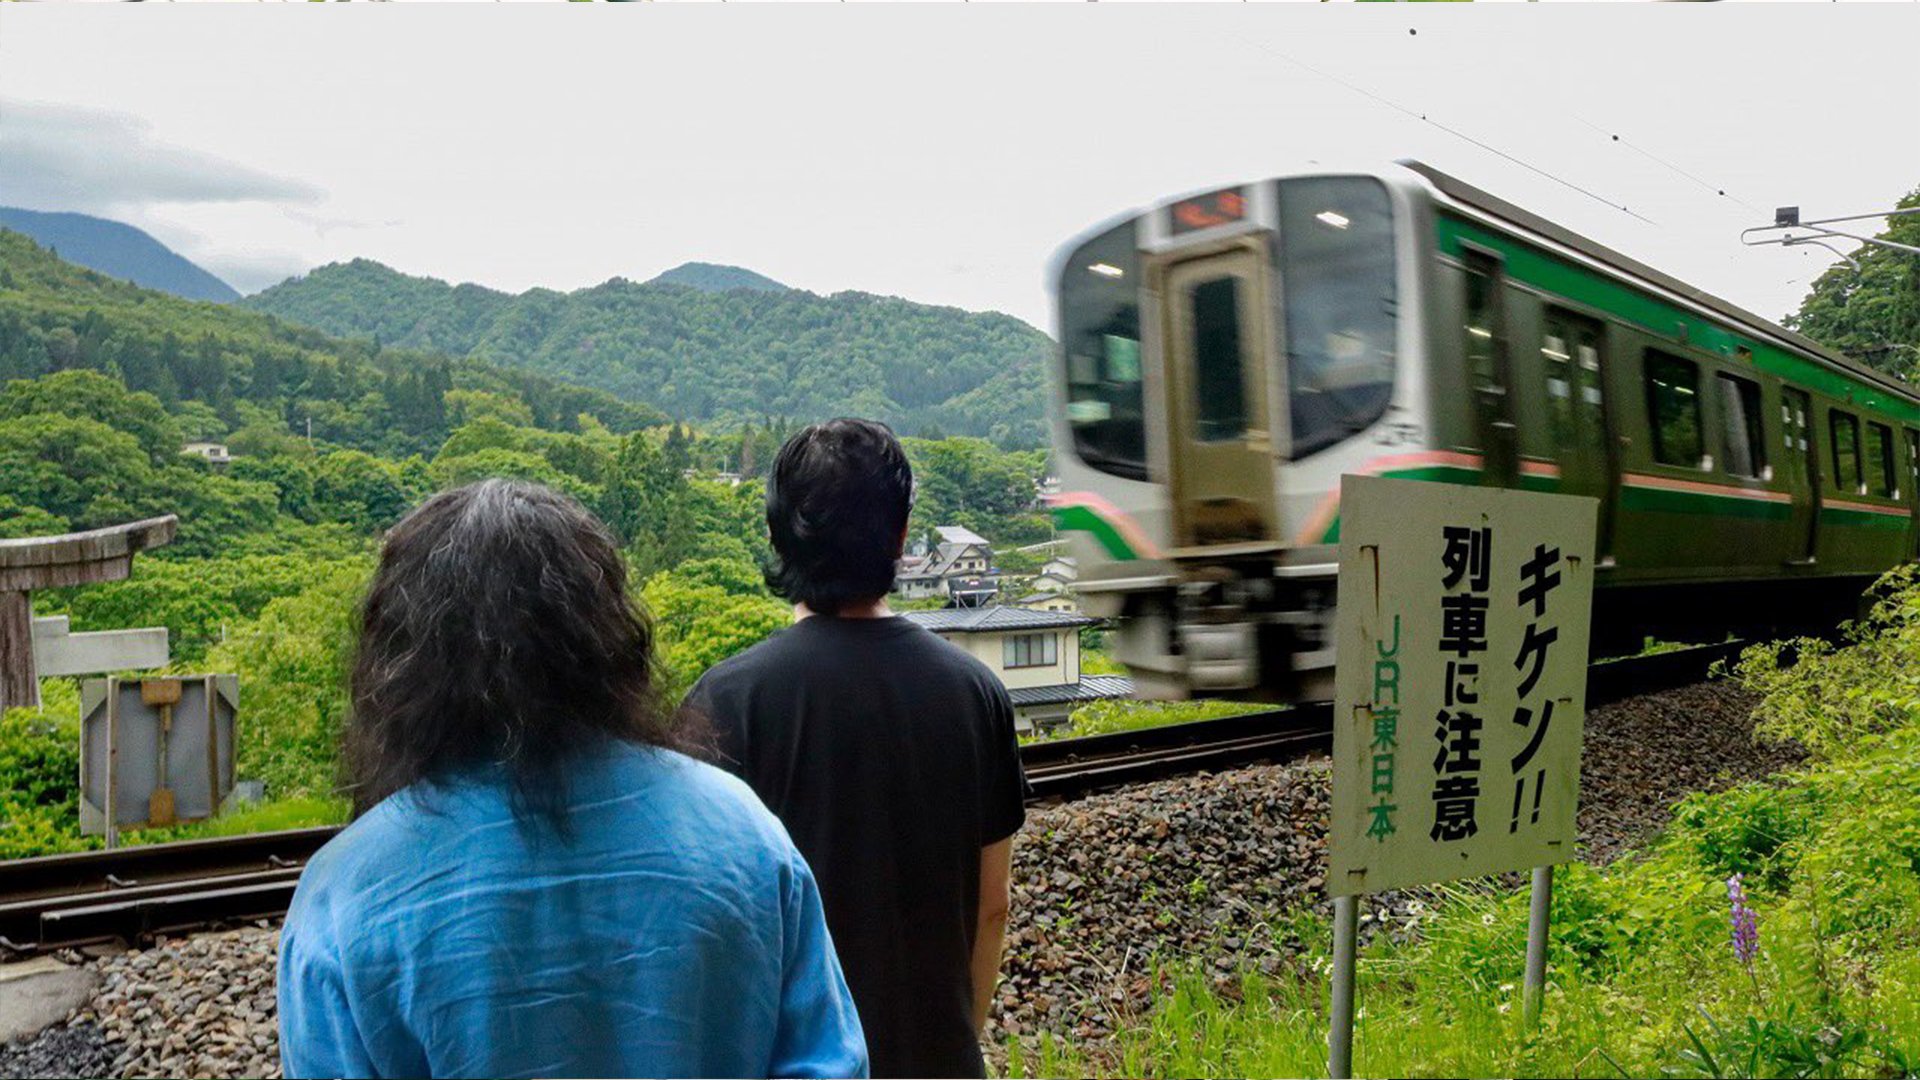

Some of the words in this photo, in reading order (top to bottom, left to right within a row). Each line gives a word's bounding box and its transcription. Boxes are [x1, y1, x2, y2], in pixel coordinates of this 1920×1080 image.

[1366, 614, 1400, 843] JR東日本
[1430, 526, 1492, 842] 列車に注意
[1509, 543, 1562, 835] キケン!!
